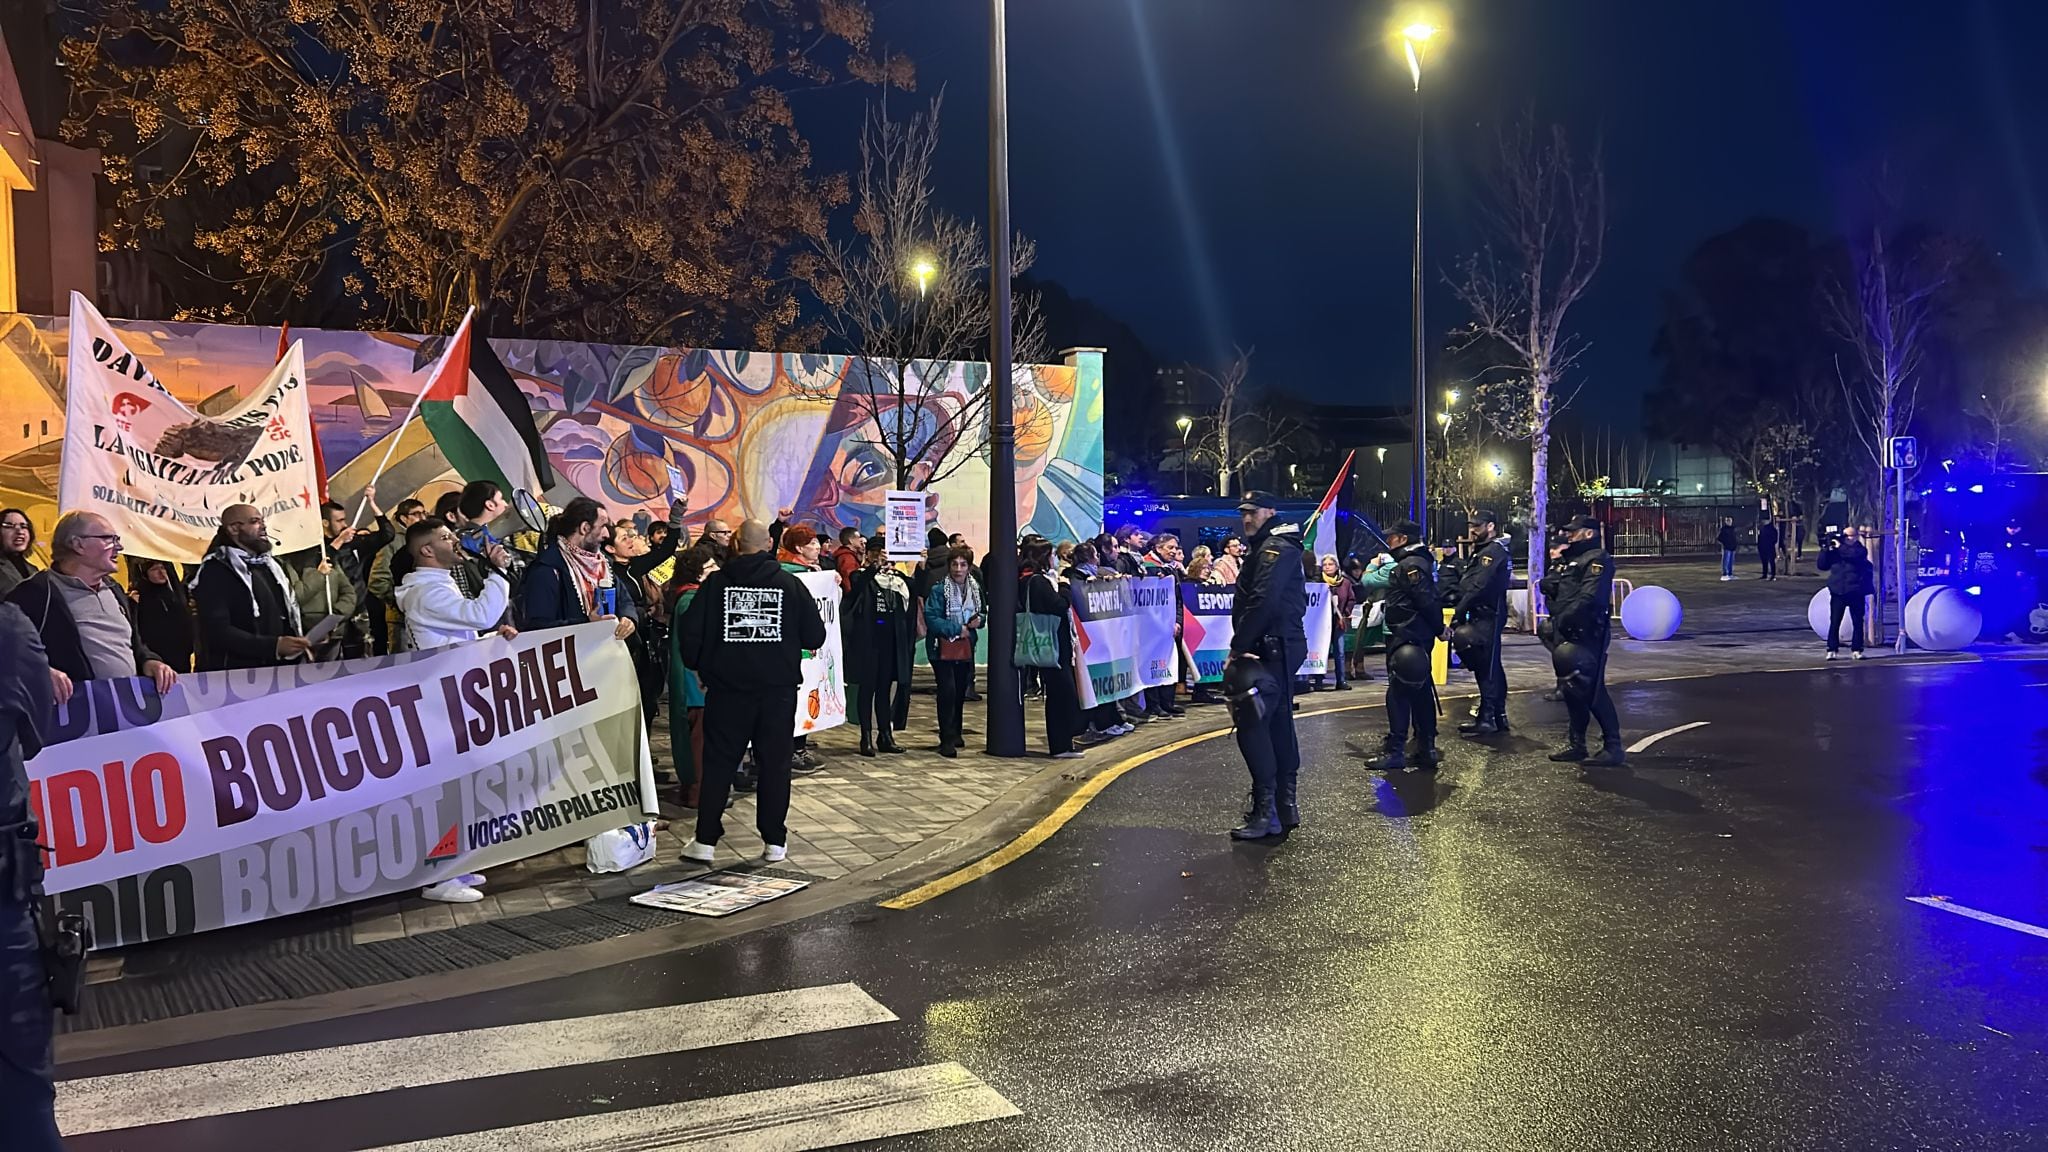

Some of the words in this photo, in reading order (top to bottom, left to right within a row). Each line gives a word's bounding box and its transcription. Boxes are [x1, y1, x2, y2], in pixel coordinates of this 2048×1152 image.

[94, 424, 125, 456] LA
[125, 445, 213, 485] IGNITAT
[1088, 590, 1113, 613] ESPORT
[201, 684, 432, 829] BOICOT
[440, 634, 599, 755] ISRAEL
[468, 813, 523, 851] VOCES
[521, 803, 564, 837] POR
[559, 780, 643, 824] PALESTIN
